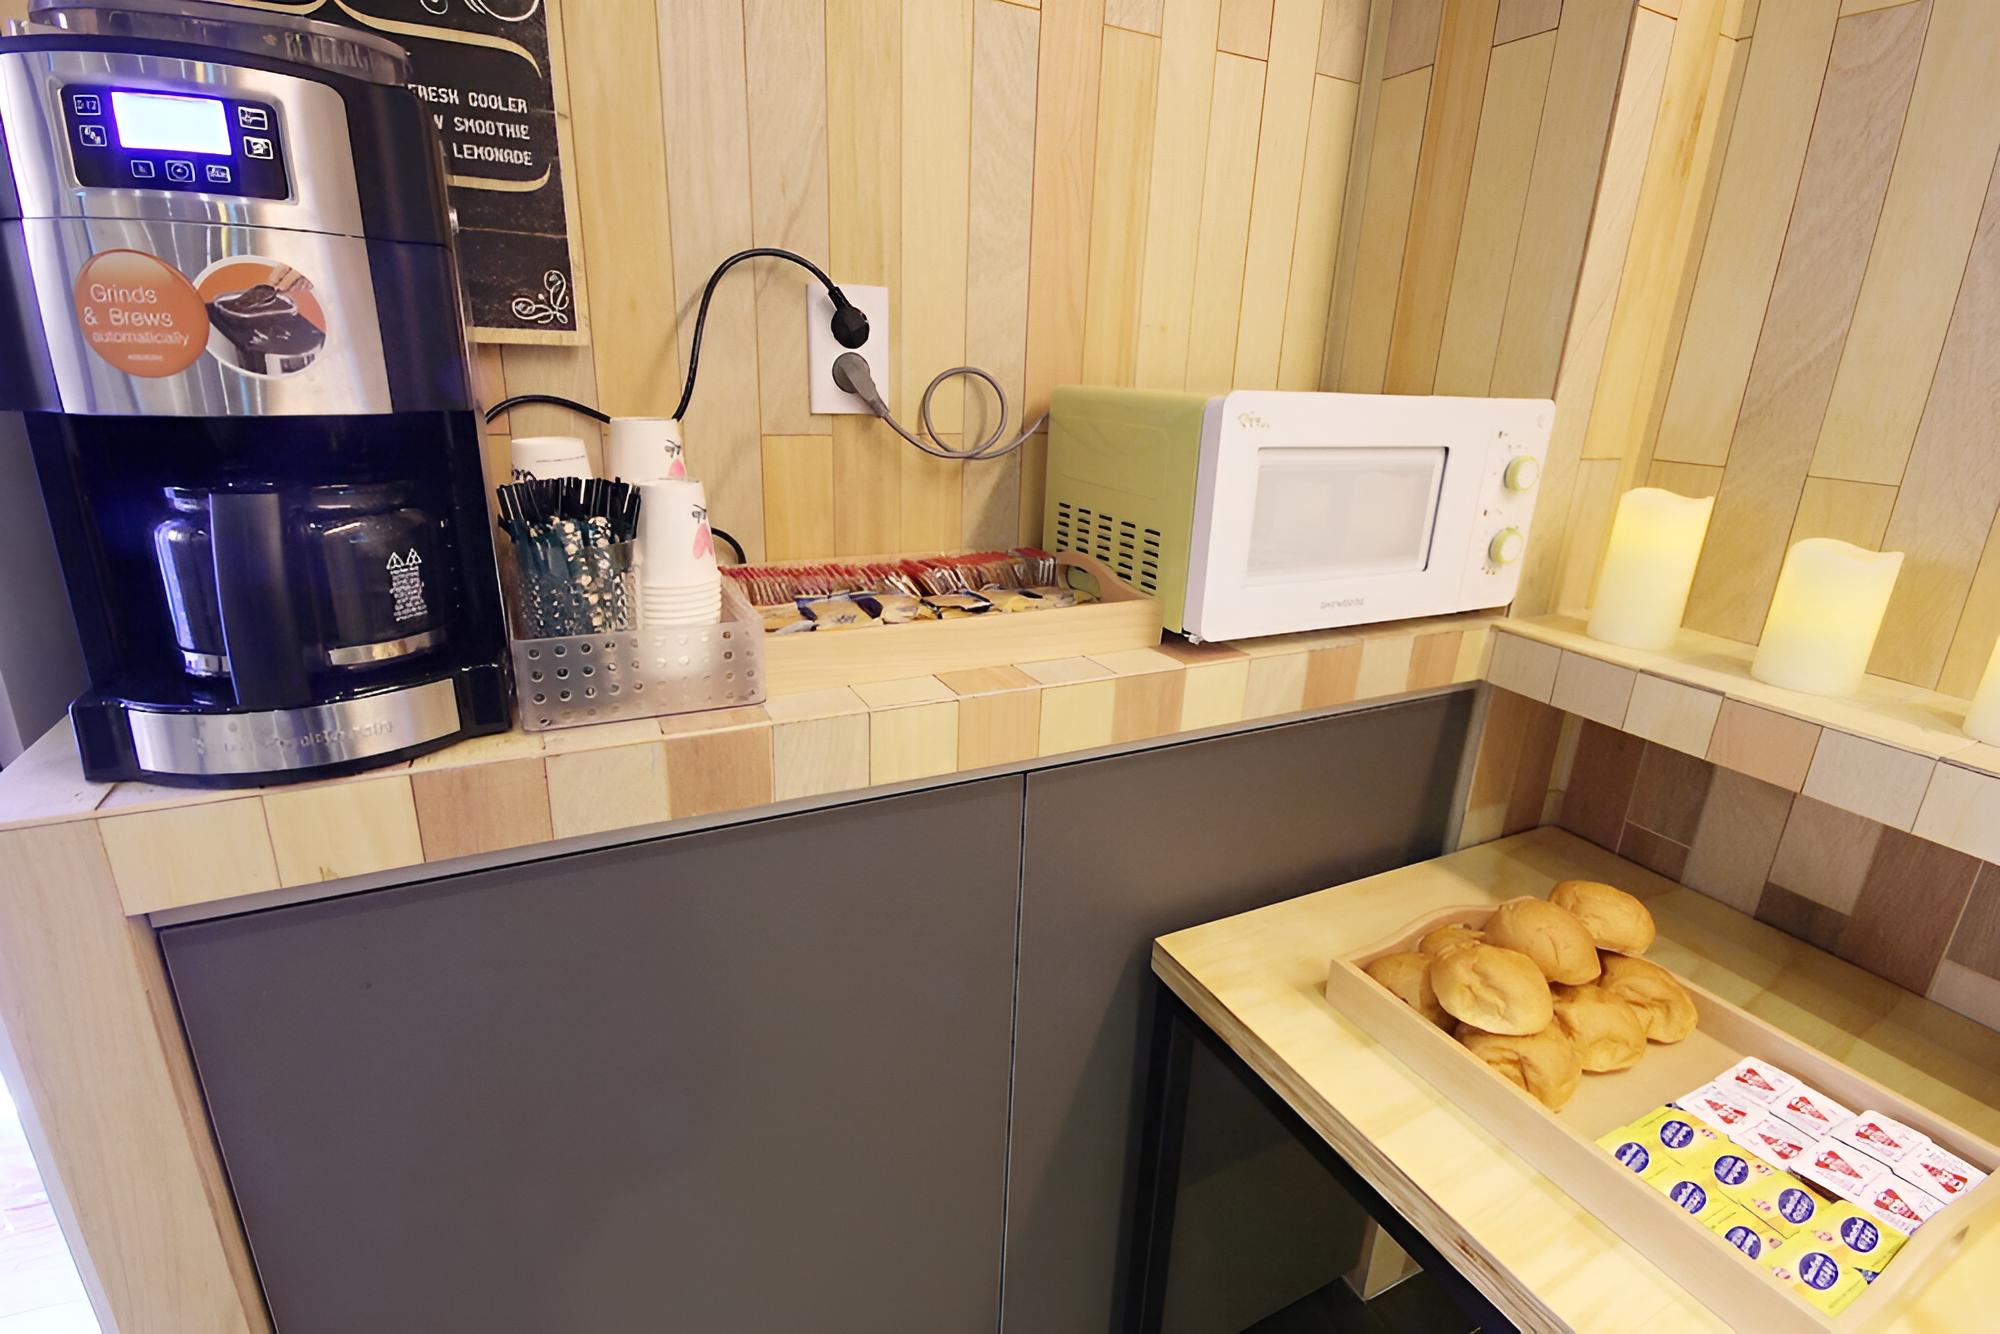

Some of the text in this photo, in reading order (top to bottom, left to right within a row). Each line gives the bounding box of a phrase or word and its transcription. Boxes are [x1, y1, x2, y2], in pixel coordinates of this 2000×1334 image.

[468, 92, 528, 114] COOLER
[453, 116, 531, 140] SMOOTHIE
[452, 142, 533, 166] LEMONADE
[90, 283, 158, 304] Grinds
[84, 306, 174, 327] & Brews
[92, 330, 189, 347] automatically
